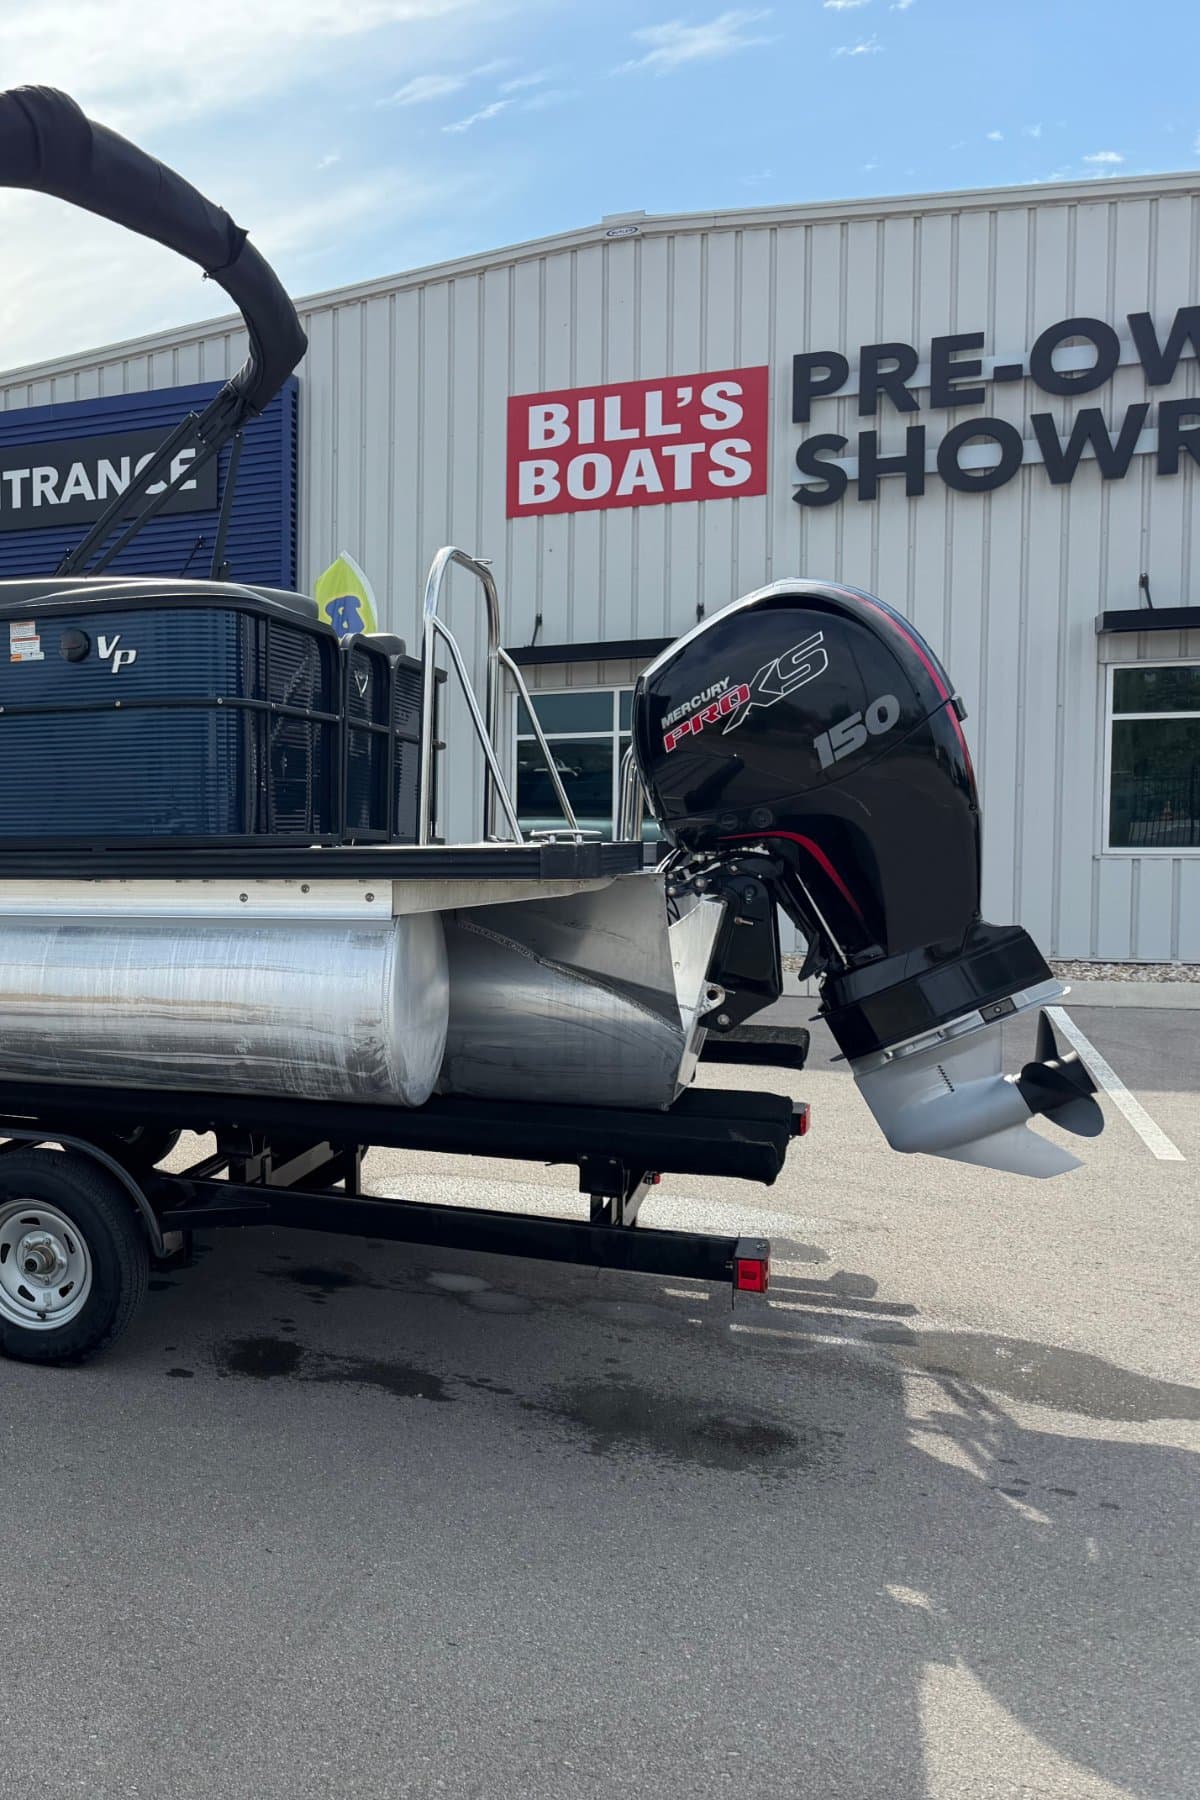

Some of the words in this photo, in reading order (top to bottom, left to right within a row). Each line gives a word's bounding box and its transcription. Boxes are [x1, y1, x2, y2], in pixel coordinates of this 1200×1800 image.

[528, 381, 743, 450] BILL'S
[518, 438, 752, 505] BOATS
[661, 676, 730, 730] MERCURY
[813, 694, 900, 770] 150
